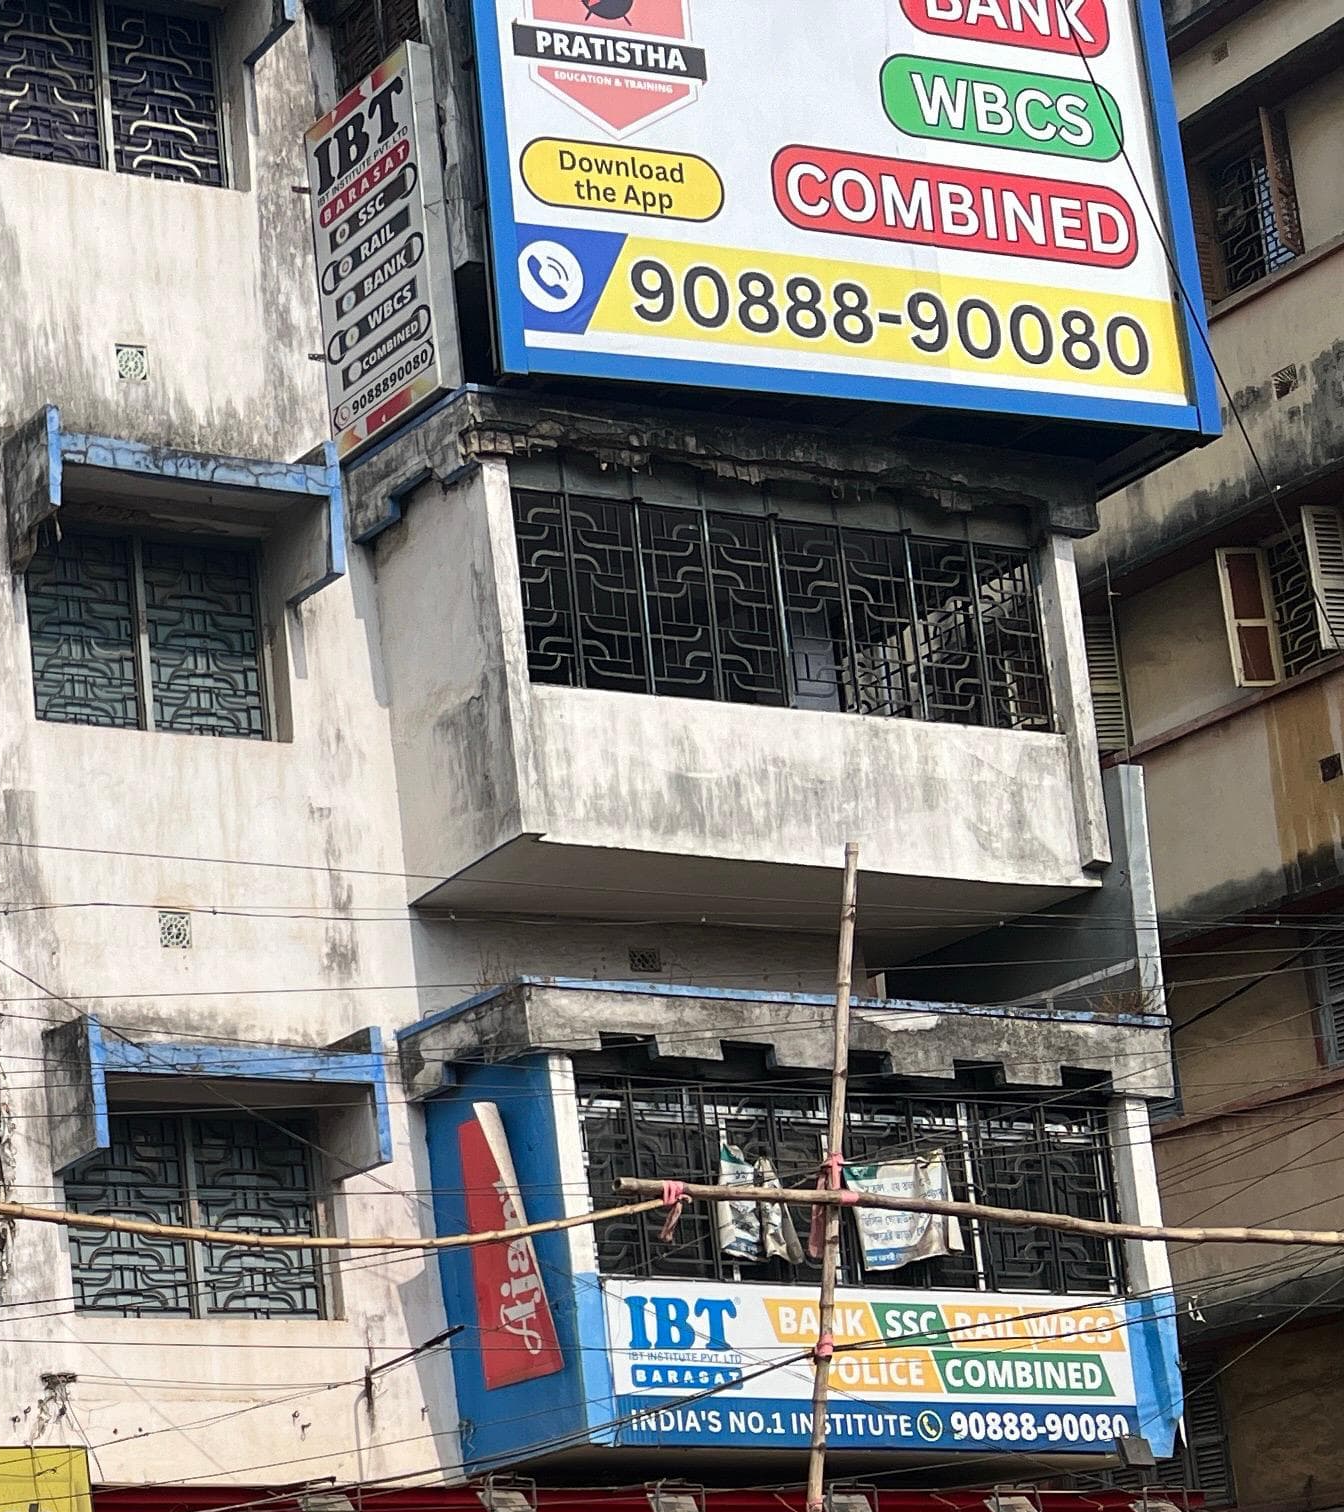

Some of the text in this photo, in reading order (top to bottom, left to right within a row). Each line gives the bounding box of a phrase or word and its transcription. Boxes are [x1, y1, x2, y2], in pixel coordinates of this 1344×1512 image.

[535, 30, 687, 72] PRATISTHA
[554, 71, 673, 93] EDUCATION & TRAINING
[909, 70, 1094, 148] WBCS
[314, 77, 403, 196] IBT
[324, 145, 407, 225] BARASAT
[559, 150, 684, 184] Download
[358, 197, 384, 226] SSC
[575, 179, 673, 213] the App
[786, 163, 1128, 253] COMBINED
[360, 224, 394, 259] RAIL
[364, 250, 407, 297] BANK
[368, 283, 412, 330] WBCS
[631, 259, 1150, 376] 90888-90080
[361, 322, 418, 370] COMBINED
[351, 348, 428, 416] 9088890080
[624, 1296, 737, 1350] IBT
[778, 1306, 1113, 1343] BANK SSC RAIL WBCS
[635, 1368, 741, 1386] BARASAT
[648, 1352, 699, 1362] INSTITUTE
[945, 1357, 1102, 1390] COMBINED
[631, 1408, 1130, 1443] INDIA'S NO.1 INSTITUTE 90888-90080
